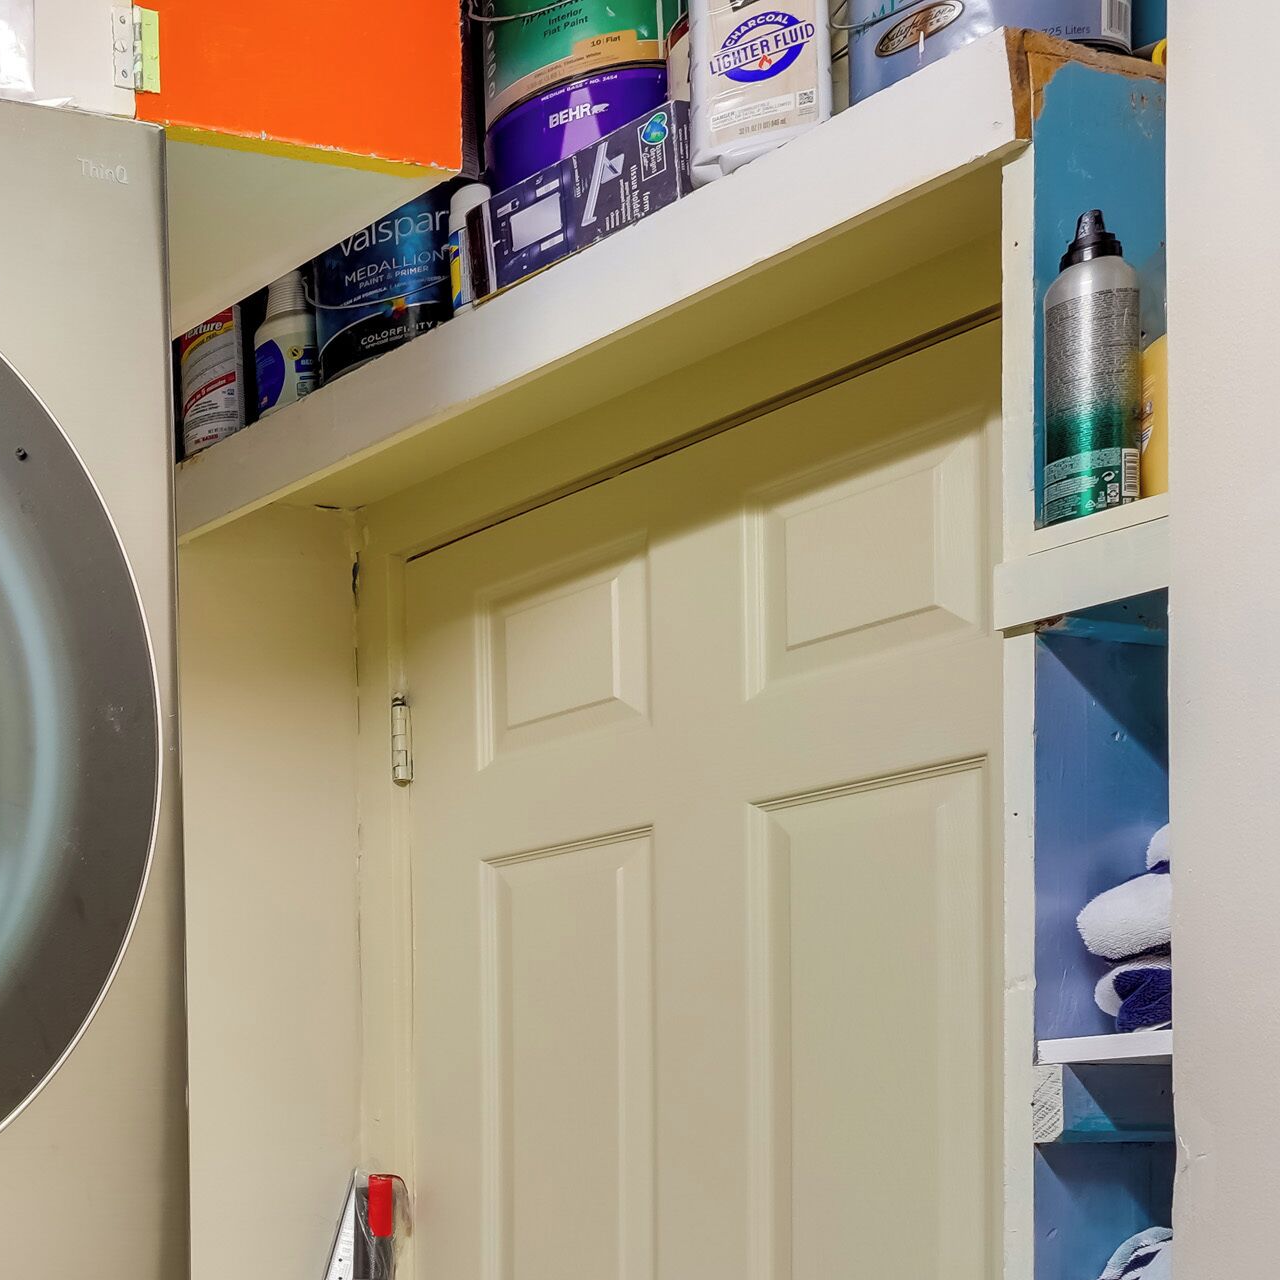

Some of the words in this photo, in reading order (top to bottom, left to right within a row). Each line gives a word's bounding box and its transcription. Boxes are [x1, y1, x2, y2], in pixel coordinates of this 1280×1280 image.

[543, 26, 561, 38] Flat
[563, 15, 589, 30] Paint
[548, 8, 583, 26] Interior
[590, 39, 602, 48] 10
[605, 35, 621, 43] Flat
[725, 14, 789, 47] CHARCOAL
[1065, 25, 1091, 35] Liters
[709, 39, 771, 76] LIGHTER
[773, 23, 815, 50] FLUID
[541, 89, 566, 102] MEDIUM
[548, 103, 591, 129] BEHR
[77, 155, 129, 185] ThinQ
[629, 164, 638, 190] tissue
[632, 189, 641, 219] holder
[642, 191, 650, 213] form
[344, 249, 444, 287] MEDALLION
[359, 274, 384, 289] PAINT
[395, 265, 429, 278] PRIMER
[360, 321, 434, 345] COLORFIITY
